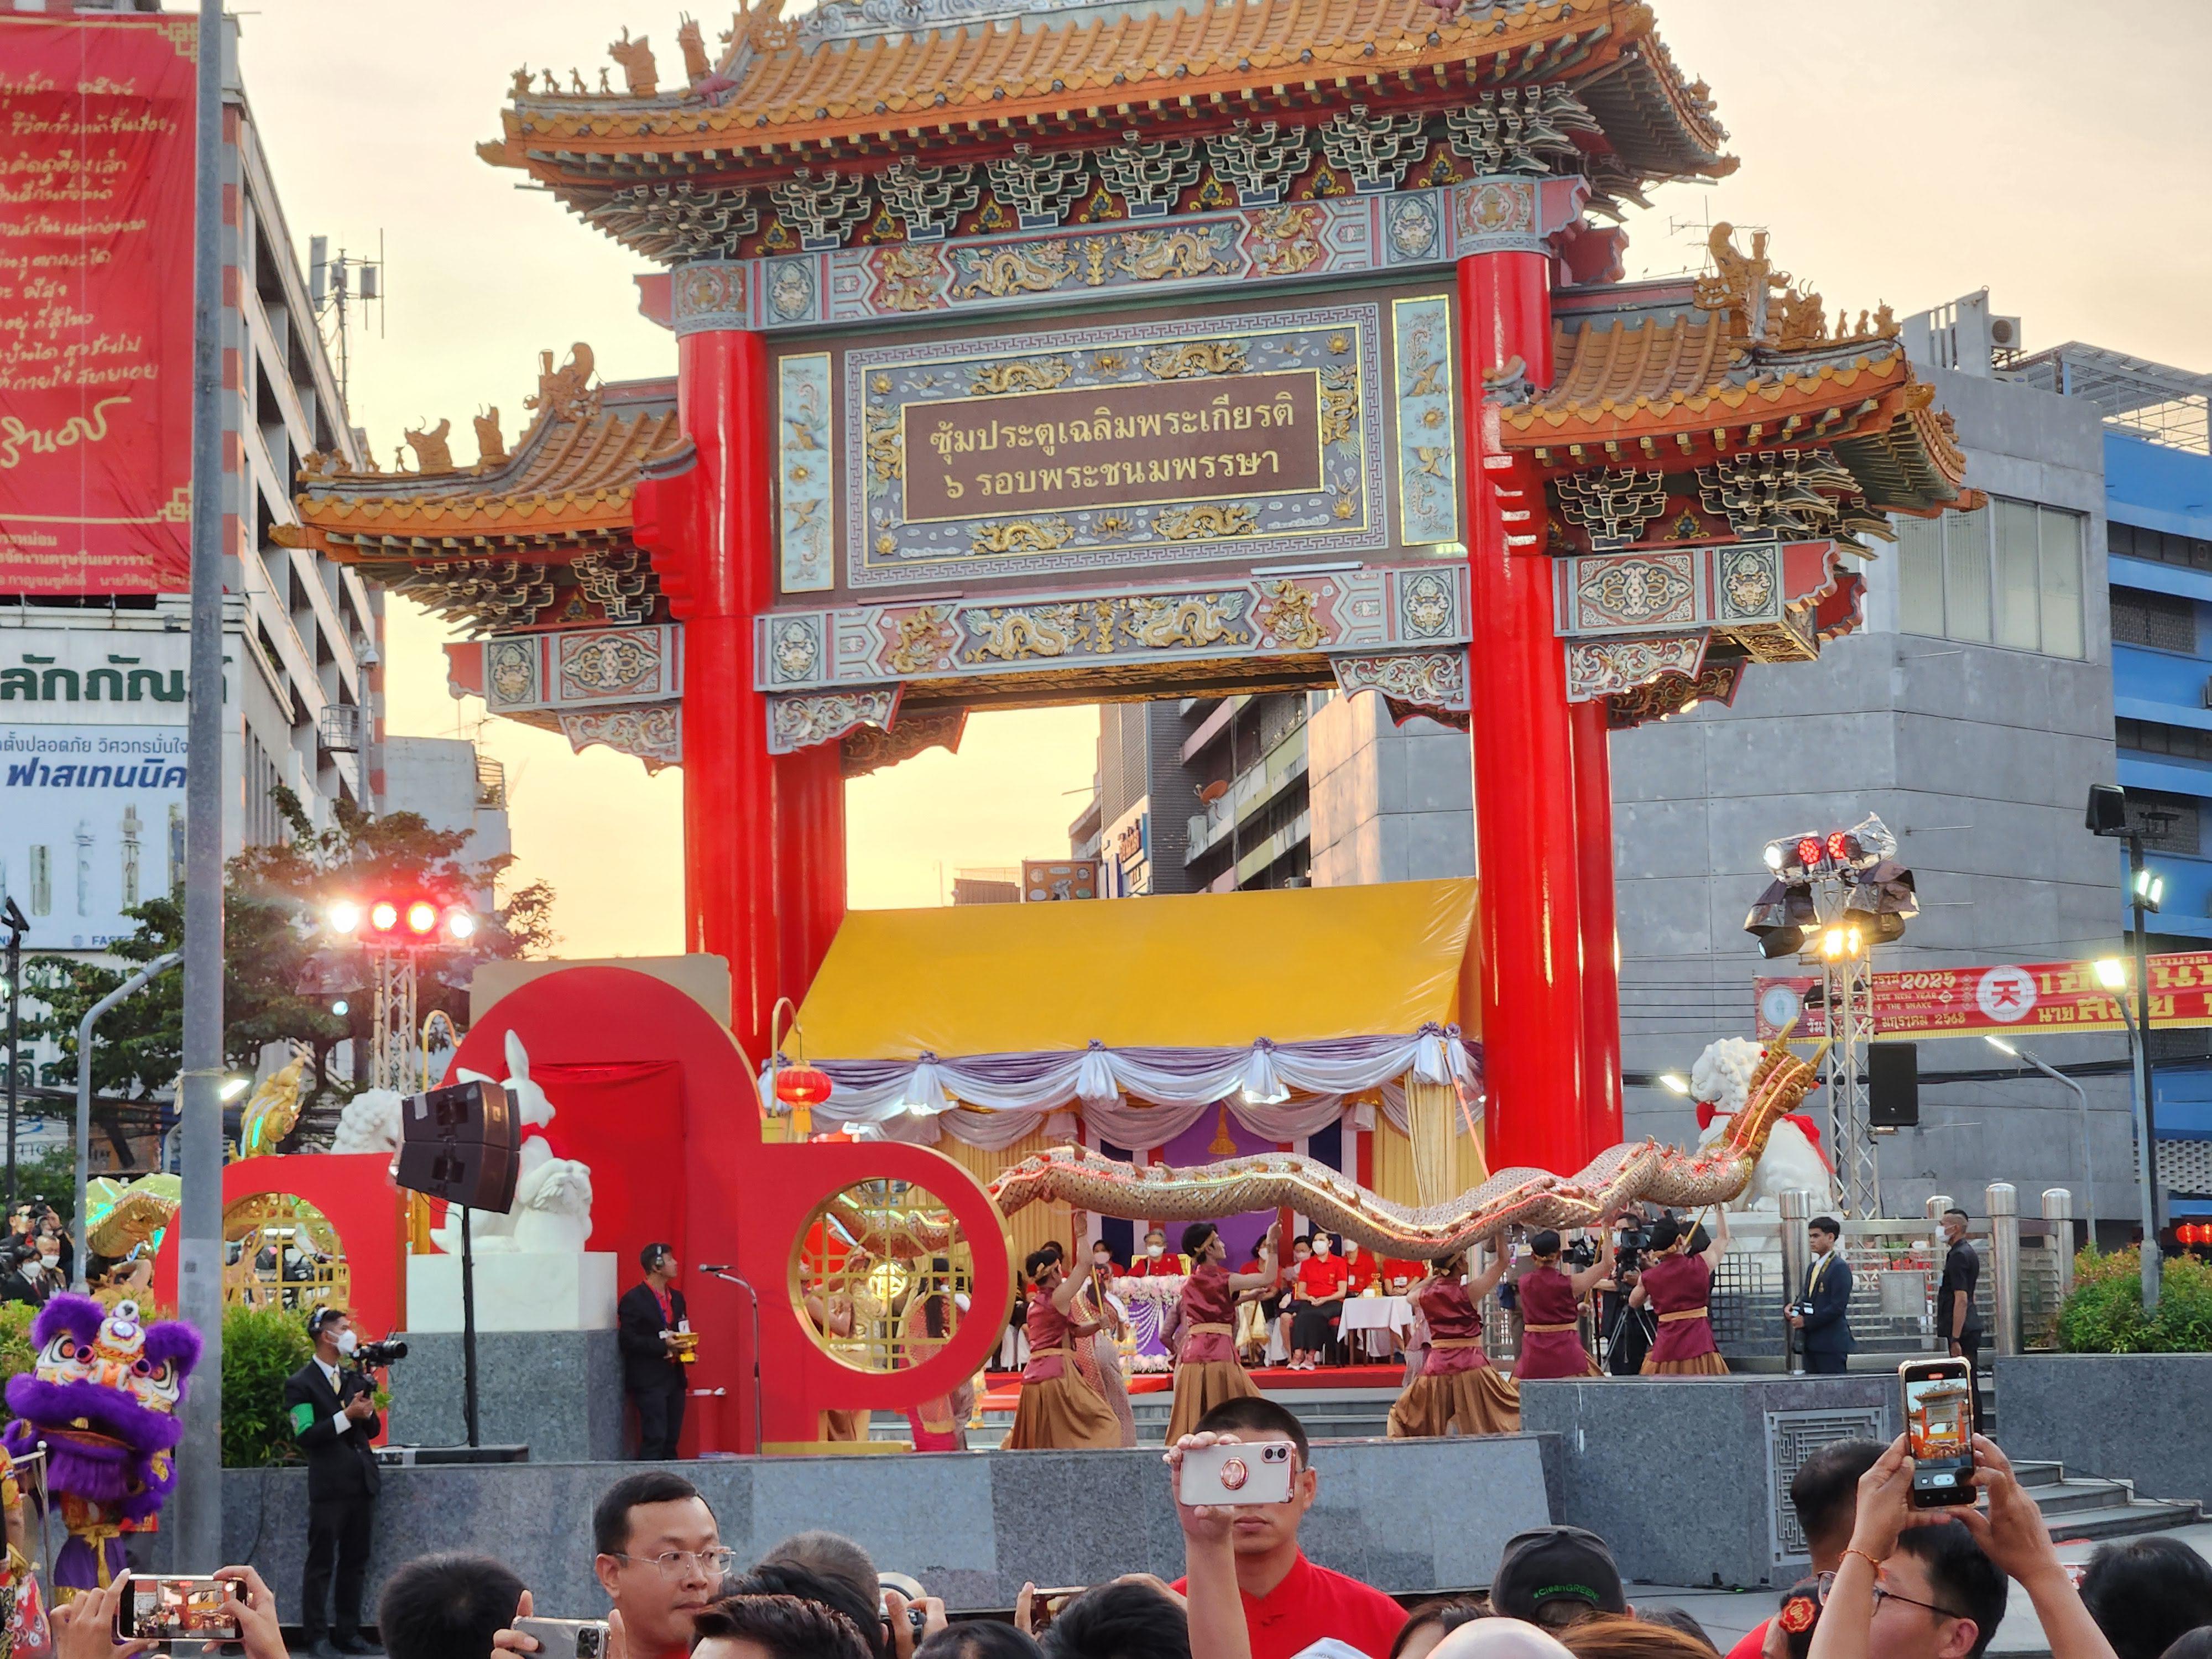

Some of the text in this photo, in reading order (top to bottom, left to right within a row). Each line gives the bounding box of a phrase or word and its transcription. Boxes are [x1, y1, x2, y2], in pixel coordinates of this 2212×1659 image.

[930, 390, 1294, 465] ซุ้มประตูเฉลิมพระเกียรติ
[943, 450, 1279, 498] ๖ รอบพระชนมพรรษา
[1901, 972, 1956, 990] 2025
[1934, 1013, 1966, 1025] 2568
